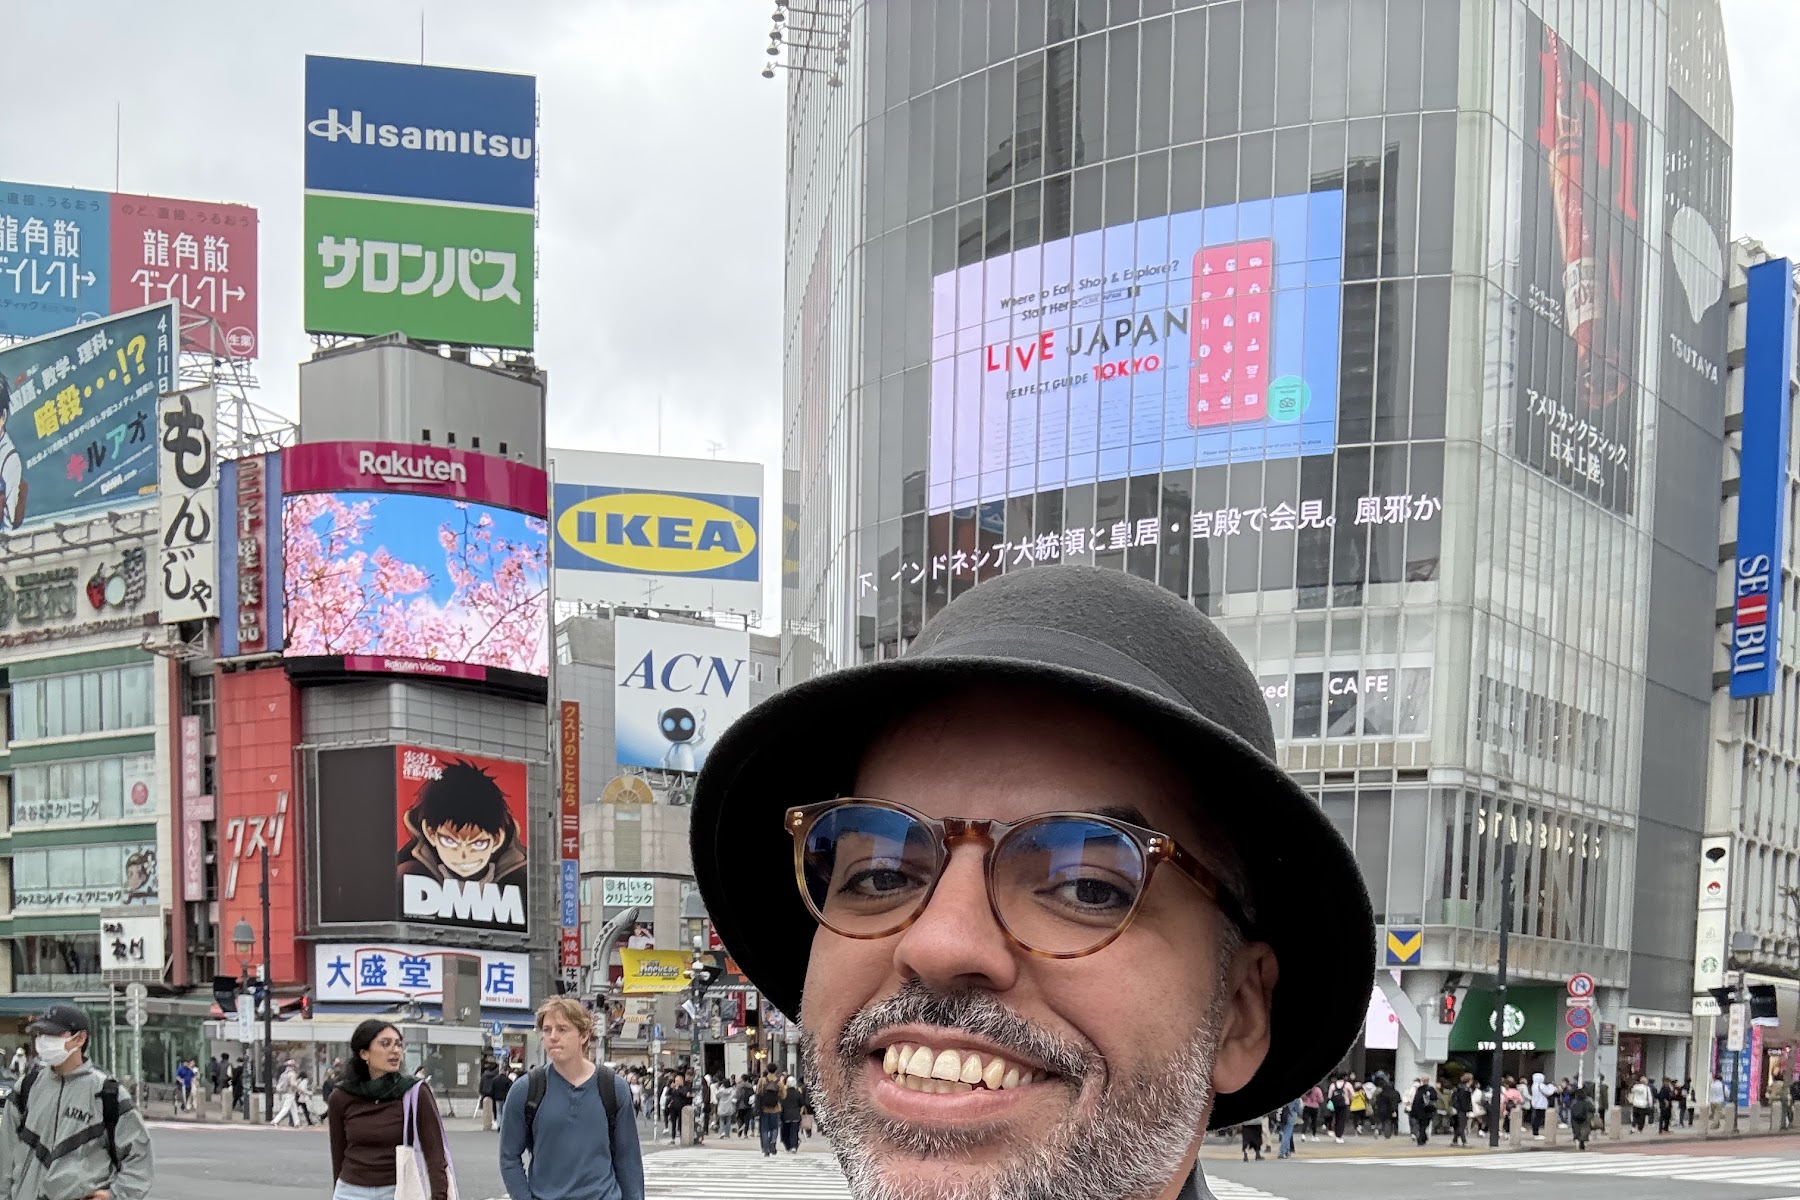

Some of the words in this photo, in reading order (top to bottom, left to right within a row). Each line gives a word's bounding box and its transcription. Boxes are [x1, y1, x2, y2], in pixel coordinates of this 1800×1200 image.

[307, 108, 533, 160] Hisamitsu
[143, 228, 229, 273] 龍角散
[318, 234, 521, 305] サロンパス
[130, 268, 246, 314] ダイレクト
[227, 334, 253, 350] 生薬
[986, 330, 1055, 373] LIVE
[1066, 307, 1188, 356] JAPAN
[1670, 333, 1719, 385] TSUTAYA
[1053, 373, 1088, 390] GUIDE
[1093, 355, 1160, 382] TOKYO
[359, 450, 467, 483] Rakuten
[163, 395, 211, 613] もんじゃ
[576, 511, 743, 553] IKEA
[1732, 554, 1770, 675] SEIBU
[384, 659, 418, 673] Rakuten
[419, 662, 446, 673] Vision
[618, 649, 747, 698] ACN
[1260, 681, 1289, 699] ed
[1329, 674, 1389, 696] CAFE
[564, 706, 577, 808] クスリのことなら
[224, 789, 290, 901] クスリ
[403, 874, 526, 925] DMM
[605, 893, 653, 904] クリニック
[617, 880, 653, 891] れいわ
[326, 954, 516, 996] 大盛堂店
[1477, 1040, 1536, 1052] STABUCKS
[63, 1106, 94, 1124] ARMY
